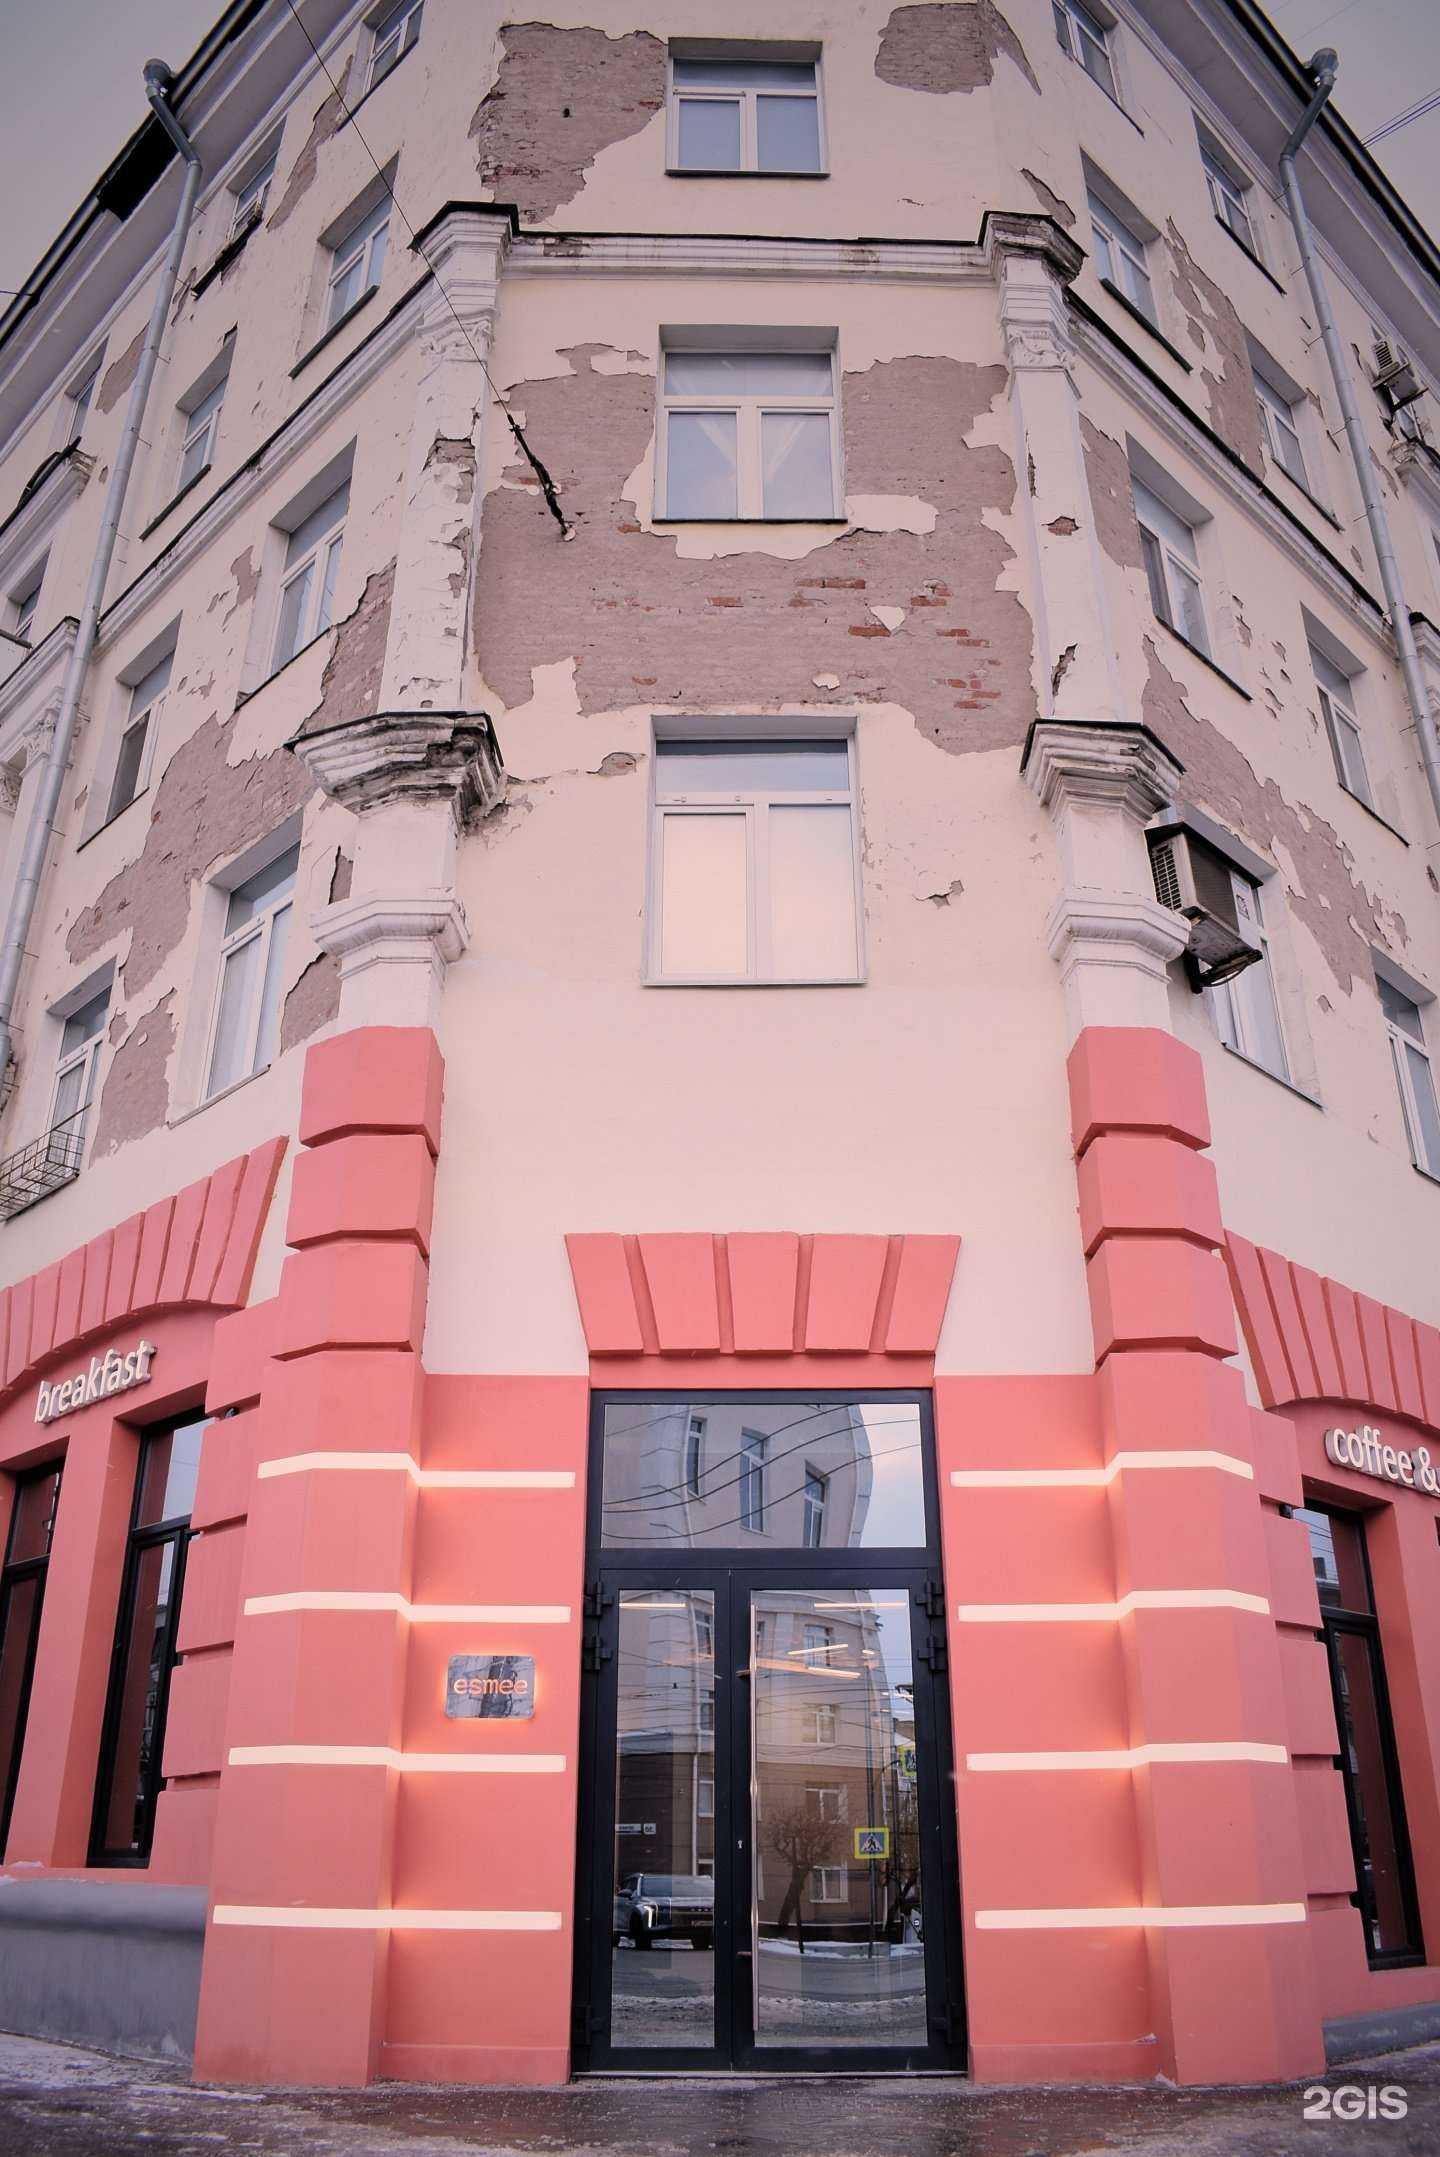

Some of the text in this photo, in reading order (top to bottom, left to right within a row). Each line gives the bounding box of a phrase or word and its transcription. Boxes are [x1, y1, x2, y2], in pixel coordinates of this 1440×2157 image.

[34, 1340, 155, 1423] breakfast
[1326, 1425, 1440, 1494] coffee &
[453, 1678, 528, 1695] esmee
